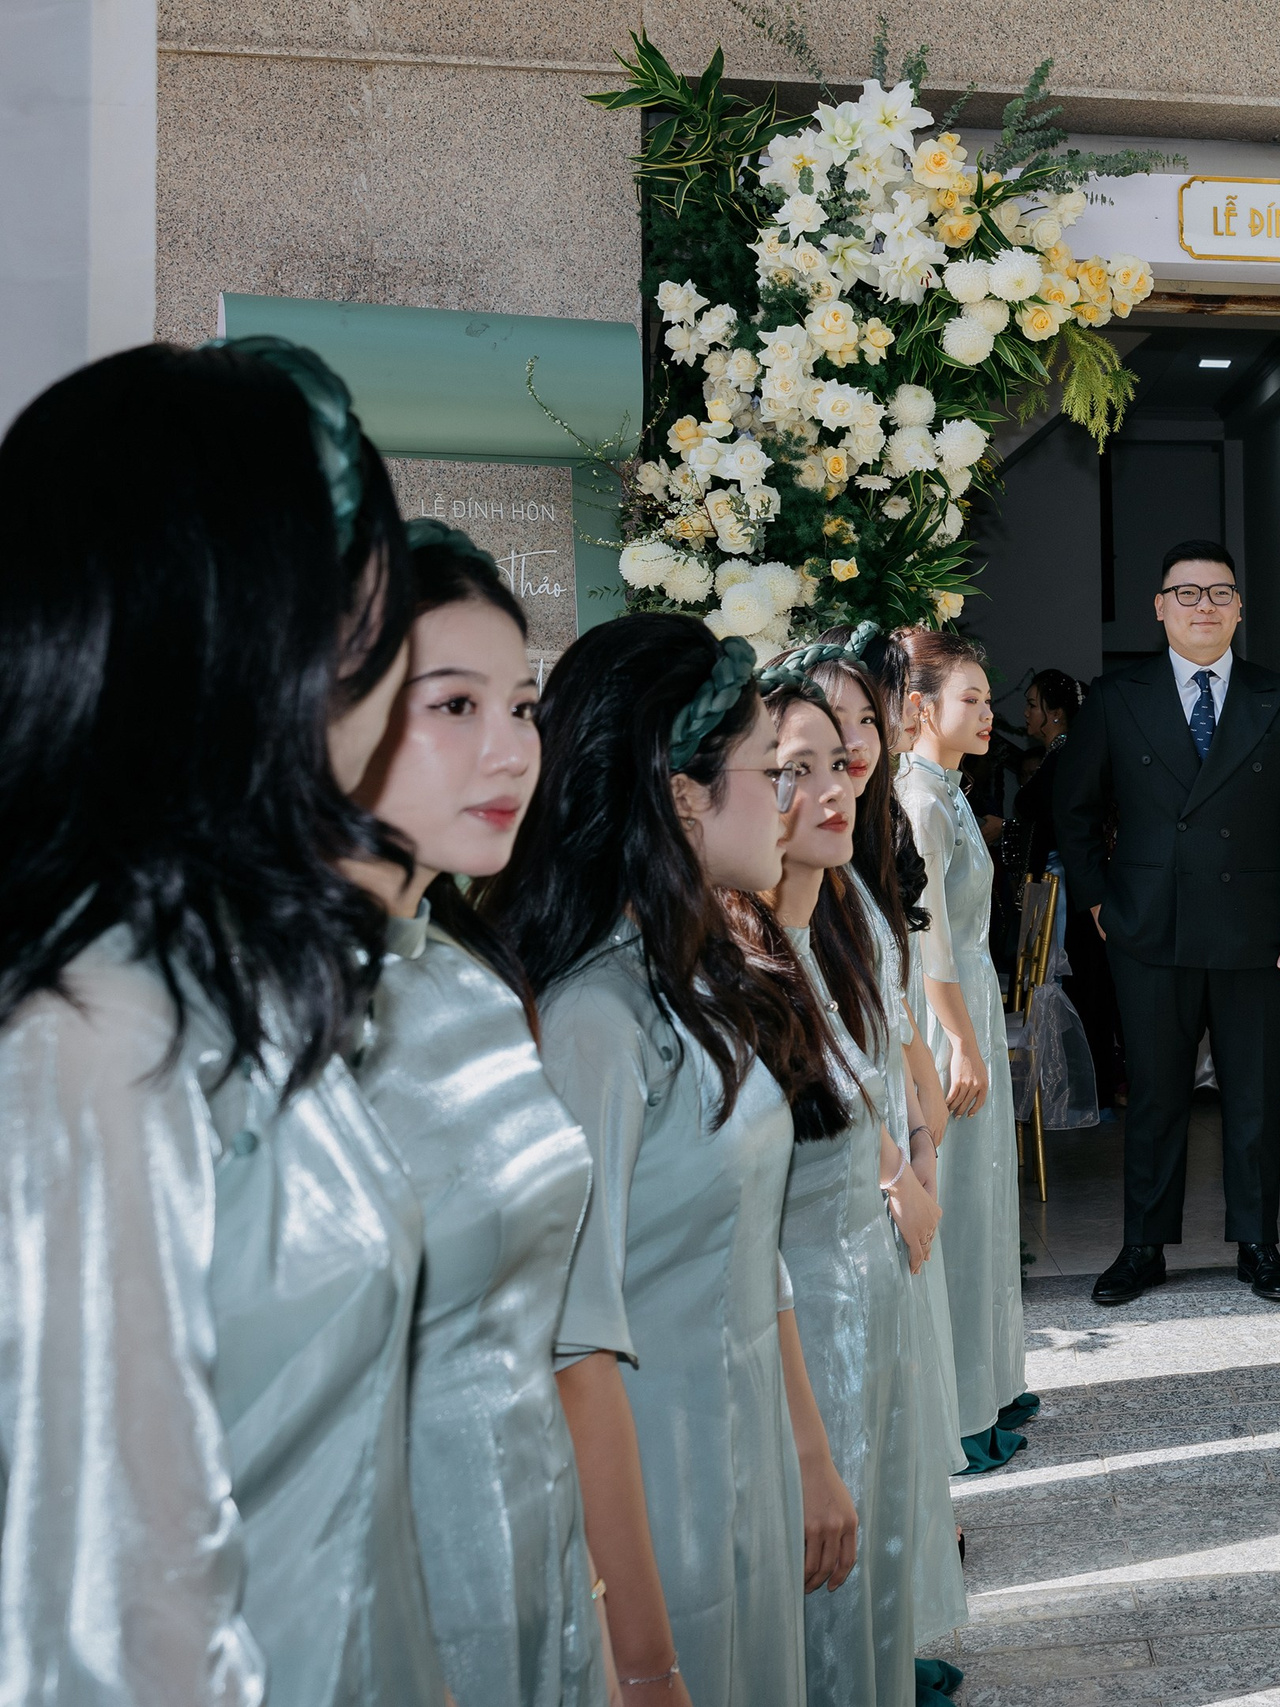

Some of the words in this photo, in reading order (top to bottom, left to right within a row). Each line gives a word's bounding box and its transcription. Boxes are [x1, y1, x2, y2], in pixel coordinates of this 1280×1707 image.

[1212, 195, 1238, 236] LỄ
[421, 493, 446, 517] LỄ
[452, 497, 504, 520] ĐÍNH
[512, 501, 556, 522] HÔN
[494, 549, 567, 599] Thảo
